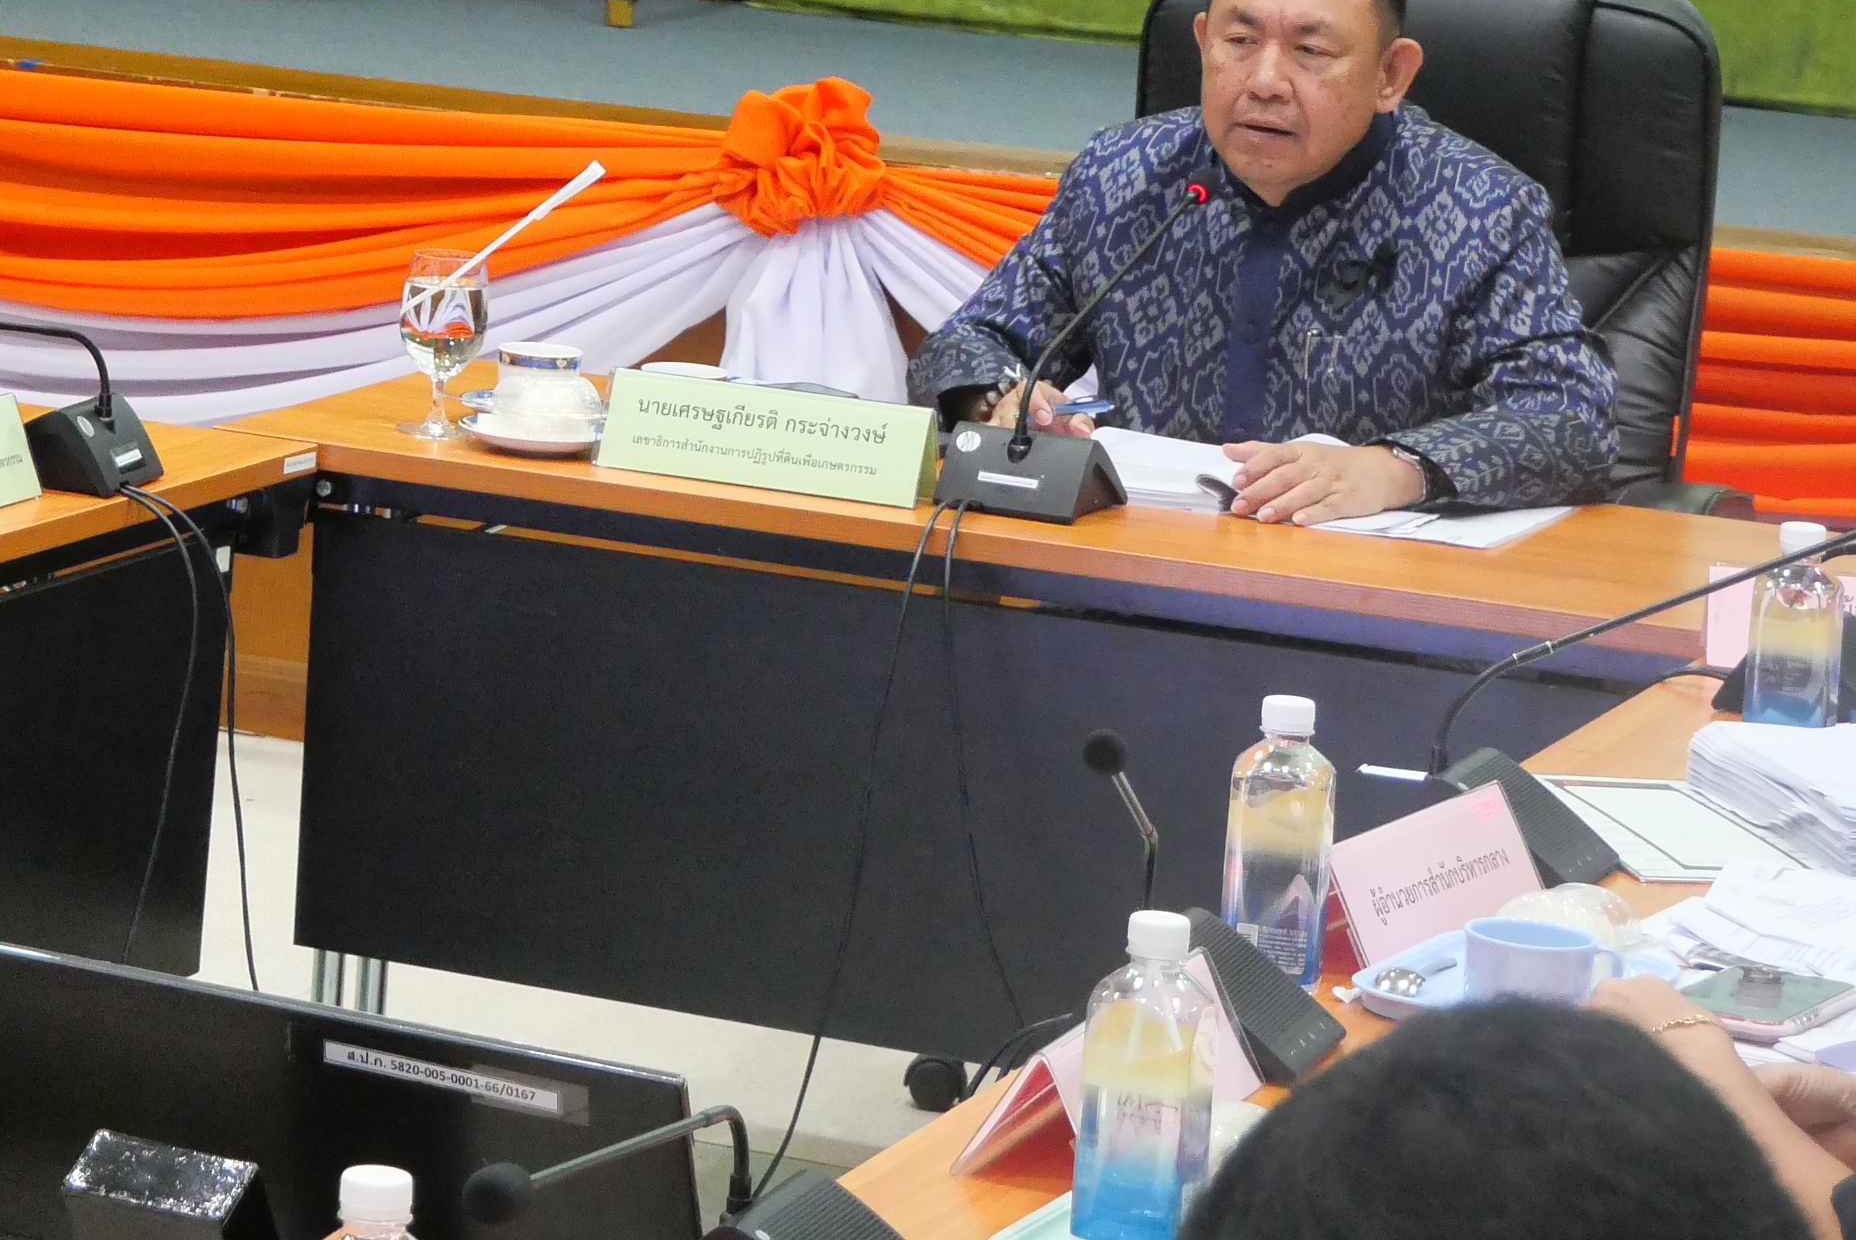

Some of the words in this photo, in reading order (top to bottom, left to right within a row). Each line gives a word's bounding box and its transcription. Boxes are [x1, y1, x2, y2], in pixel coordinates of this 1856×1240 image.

[638, 398, 779, 431] นายเศรษฐเกียรติ
[785, 417, 888, 444] กระจ่างวงษ์
[347, 1051, 387, 1070] ส.ป.ก.
[390, 1059, 536, 1102] 5820-005-0001-66/0167
